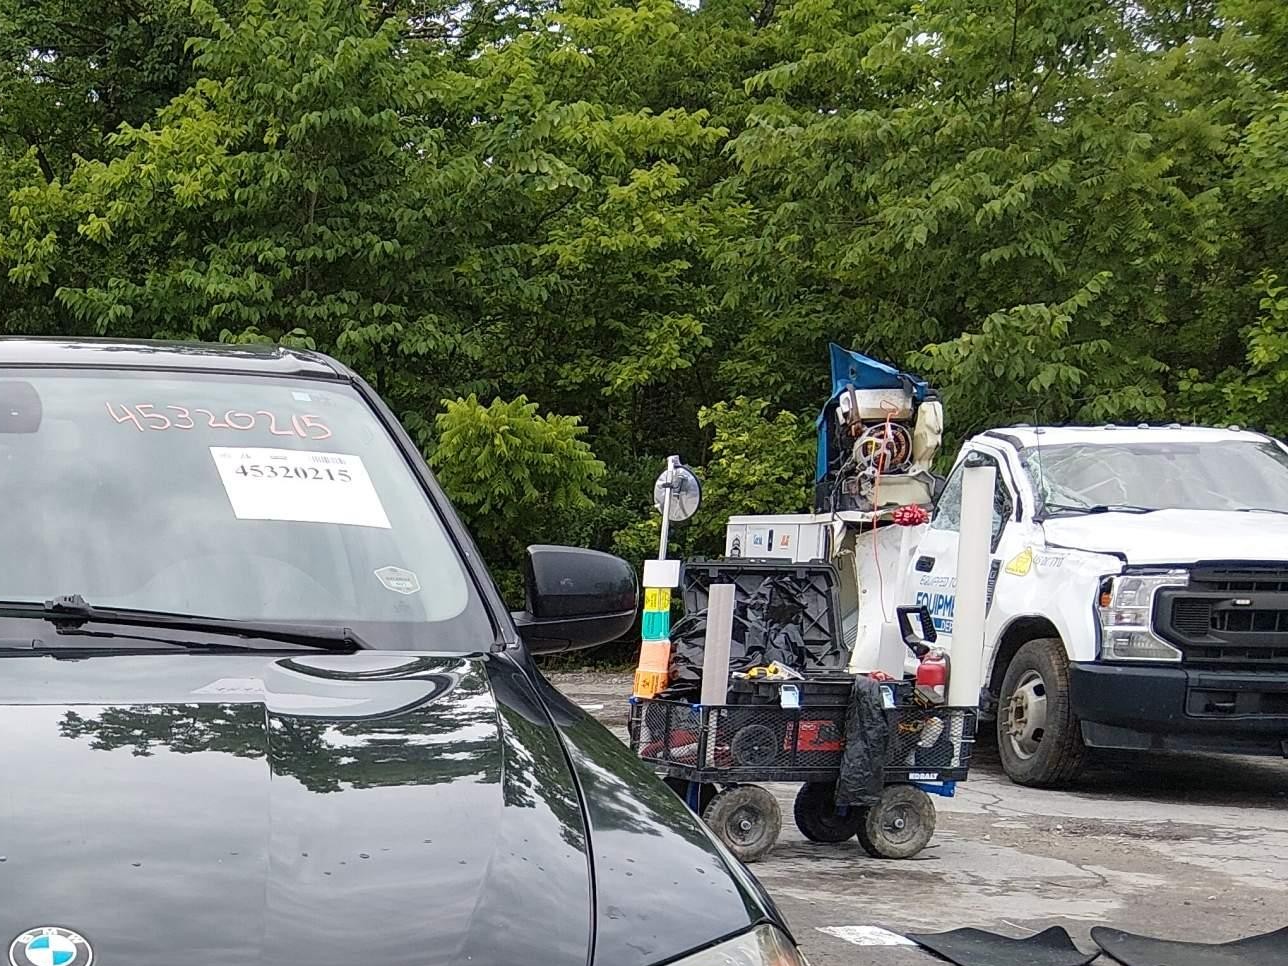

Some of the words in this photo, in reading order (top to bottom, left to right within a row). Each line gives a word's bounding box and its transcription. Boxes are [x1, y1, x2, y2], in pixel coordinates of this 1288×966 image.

[105, 400, 333, 441] 45320215
[235, 463, 353, 483] 45320215
[18, 927, 84, 944] BMW
